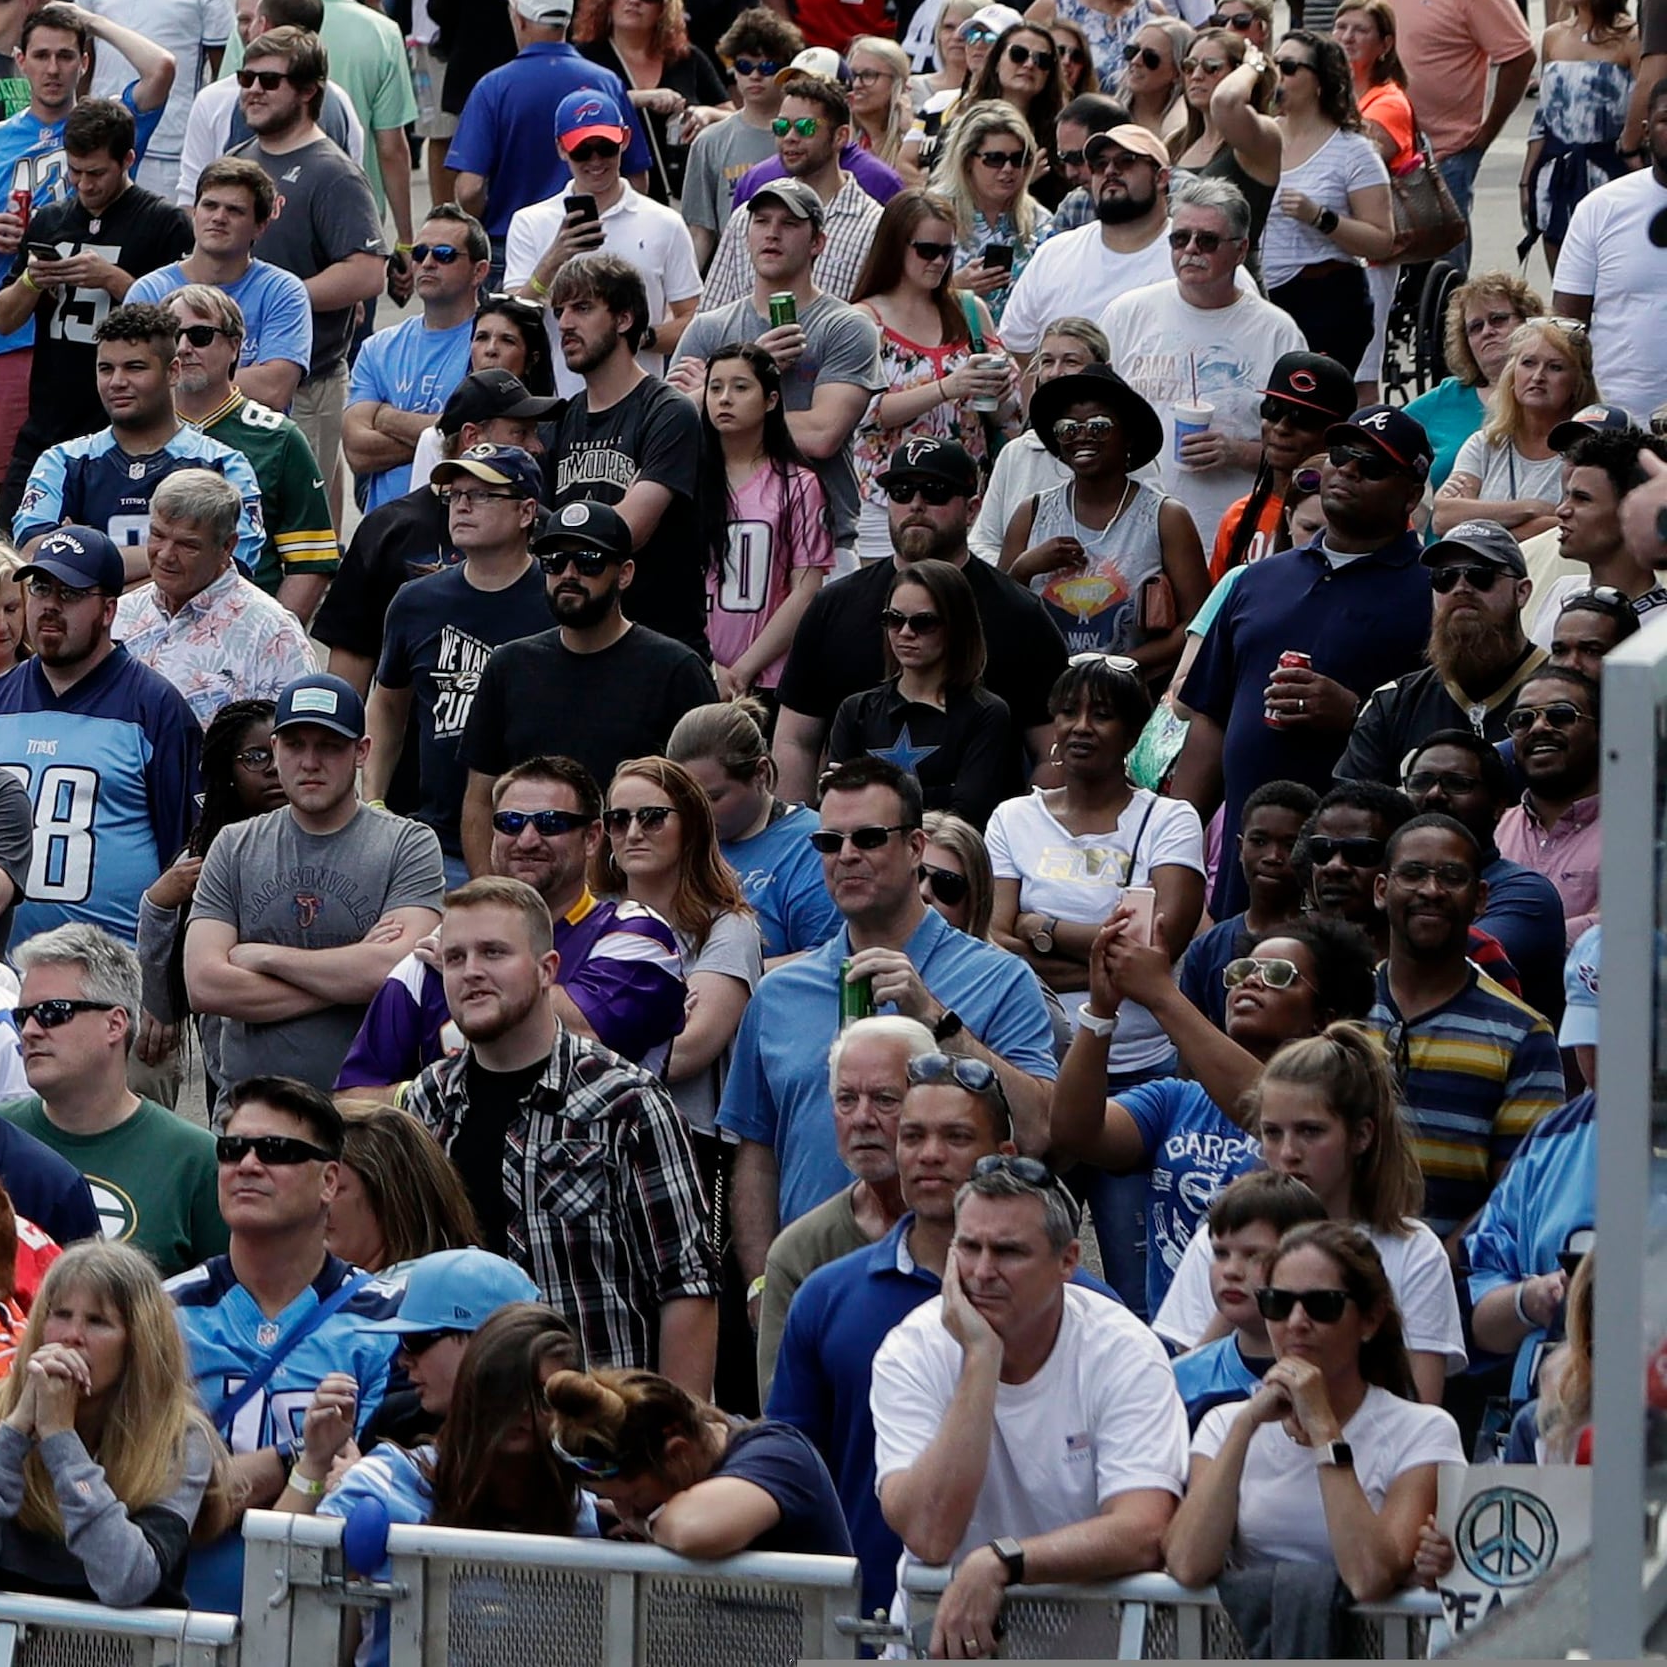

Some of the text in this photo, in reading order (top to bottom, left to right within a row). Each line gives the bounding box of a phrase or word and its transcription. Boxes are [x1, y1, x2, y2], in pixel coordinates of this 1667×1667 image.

[437, 627, 457, 673] WE
[27, 738, 60, 754] TITANS
[246, 863, 379, 931] JACKSONVILLE
